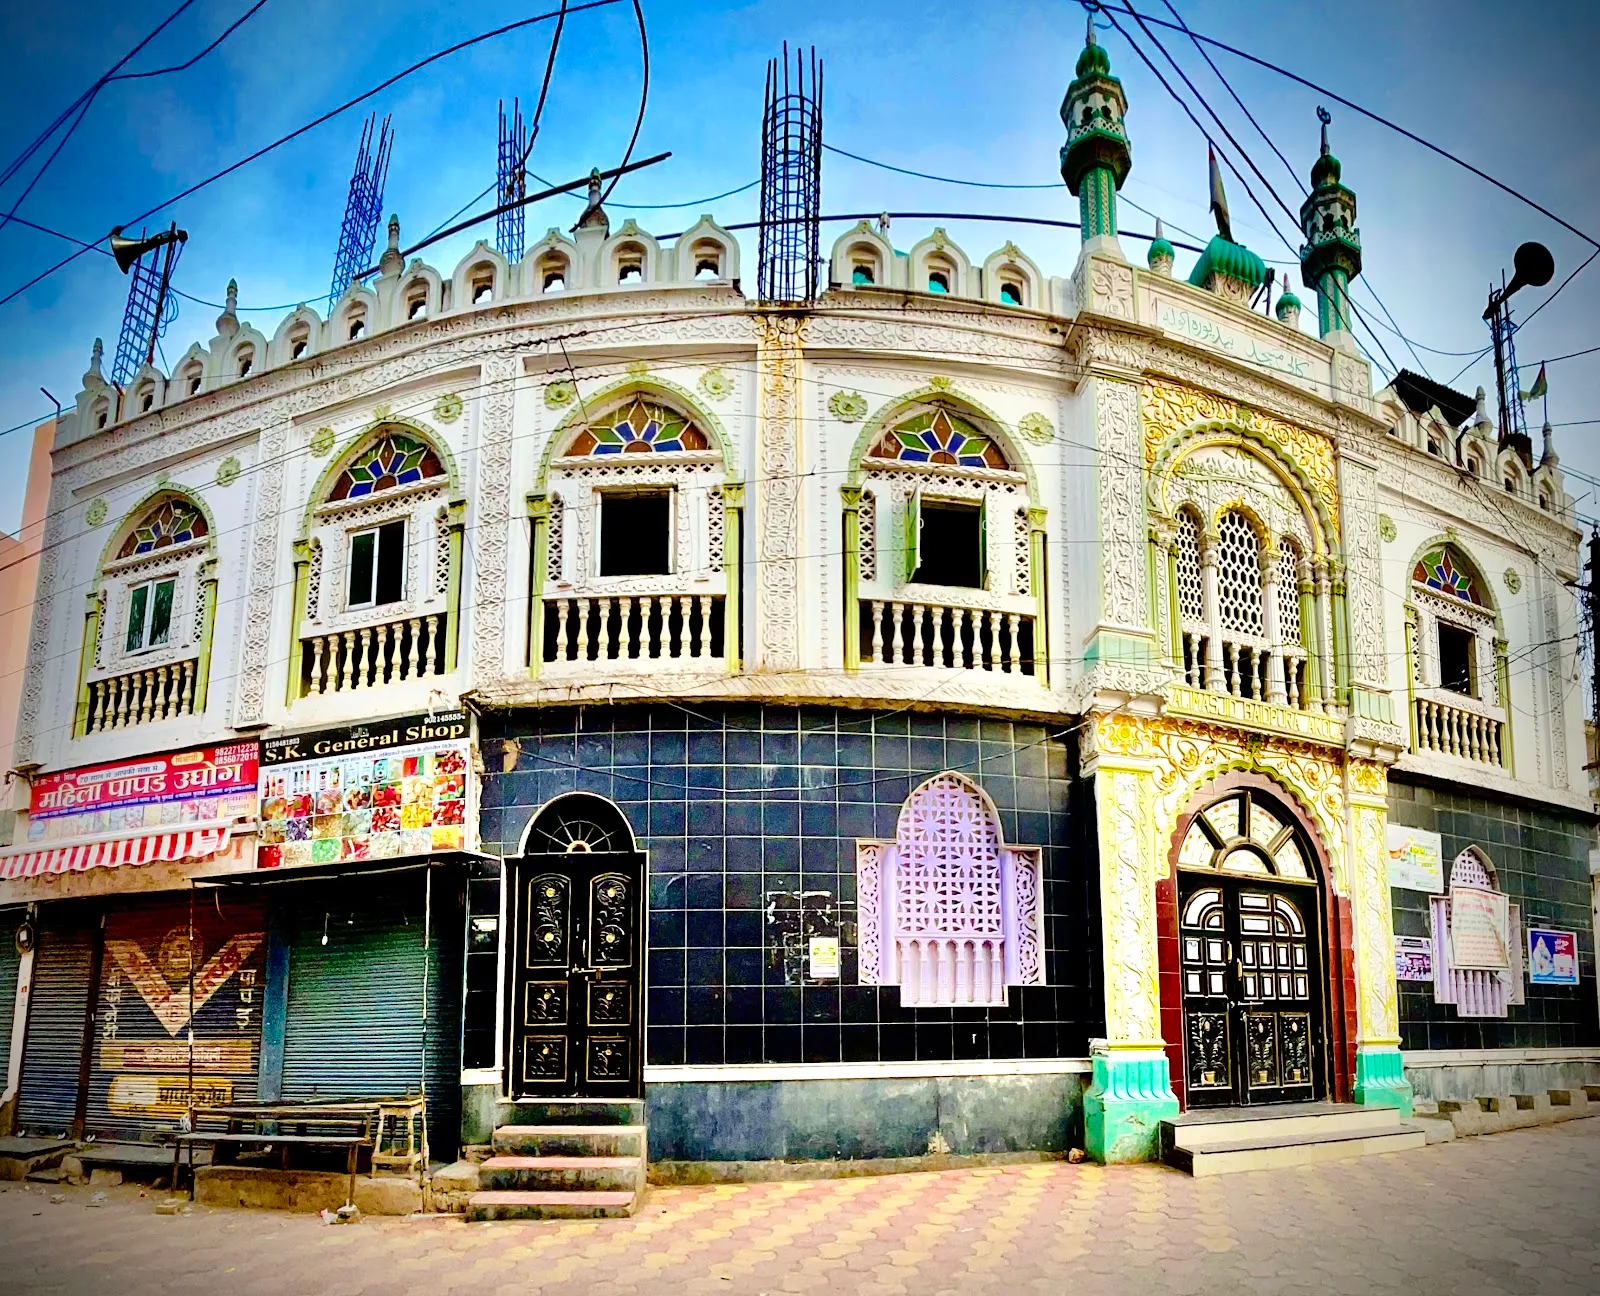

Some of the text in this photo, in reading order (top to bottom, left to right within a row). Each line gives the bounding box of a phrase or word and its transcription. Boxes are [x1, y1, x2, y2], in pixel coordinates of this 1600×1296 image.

[1244, 340, 1284, 369] مسجد
[1192, 690, 1237, 718] MASJID
[1244, 703, 1300, 733] BAIDPURA
[214, 751, 258, 765] 8856072018
[215, 742, 259, 756] 9822712230
[265, 745, 307, 762] S.K.
[313, 729, 398, 755] General
[405, 724, 464, 741] Shop
[39, 782, 104, 808] महिला
[107, 773, 168, 797] पापड
